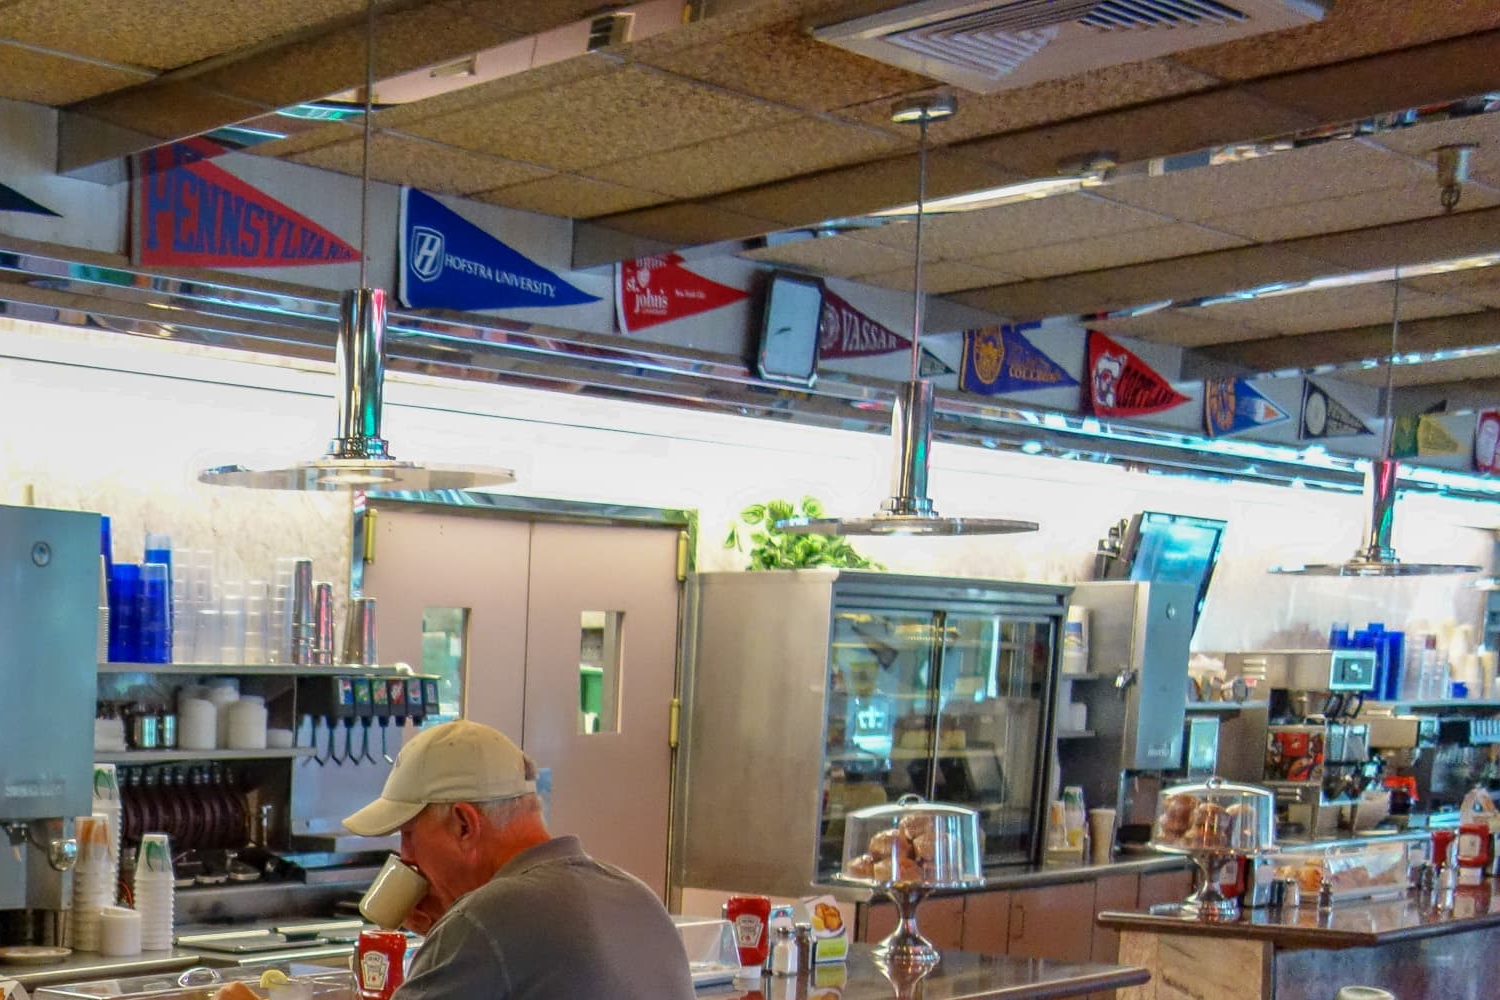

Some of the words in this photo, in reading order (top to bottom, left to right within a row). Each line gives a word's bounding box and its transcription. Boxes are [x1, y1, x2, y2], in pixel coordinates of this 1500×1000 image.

[444, 253, 493, 281] HOFSTRA
[495, 270, 556, 298] UNIVERSITY
[841, 309, 897, 351] VASSAR
